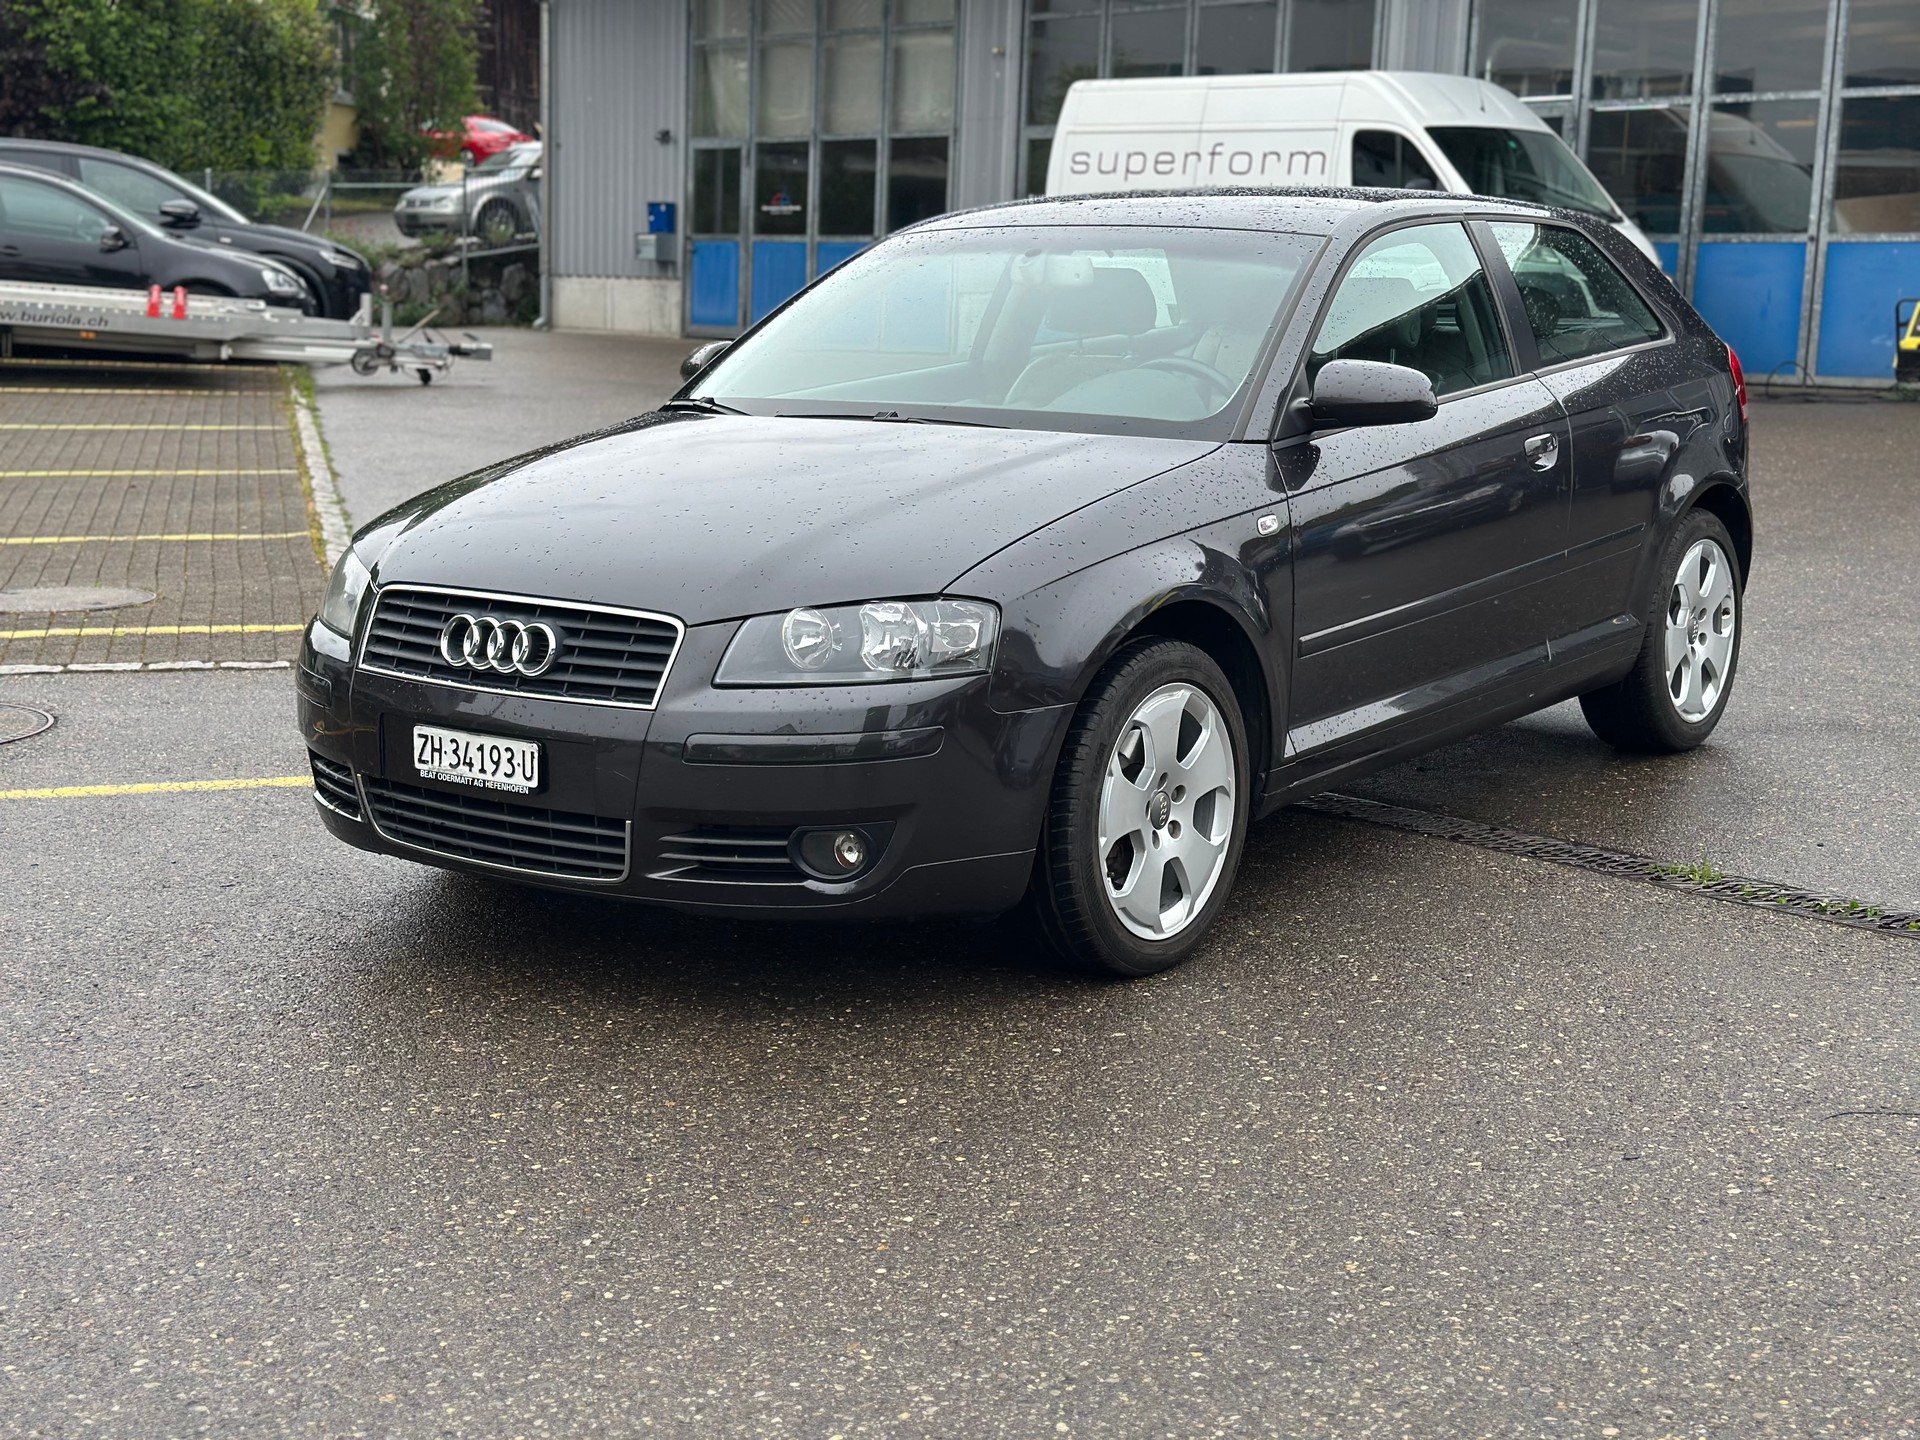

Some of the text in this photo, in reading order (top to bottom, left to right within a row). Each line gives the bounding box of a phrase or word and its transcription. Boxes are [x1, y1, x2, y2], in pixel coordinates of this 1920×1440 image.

[1070, 142, 1327, 182] superform
[420, 769, 529, 794] BEAT ODERMATT AG HEFENHOFEN
